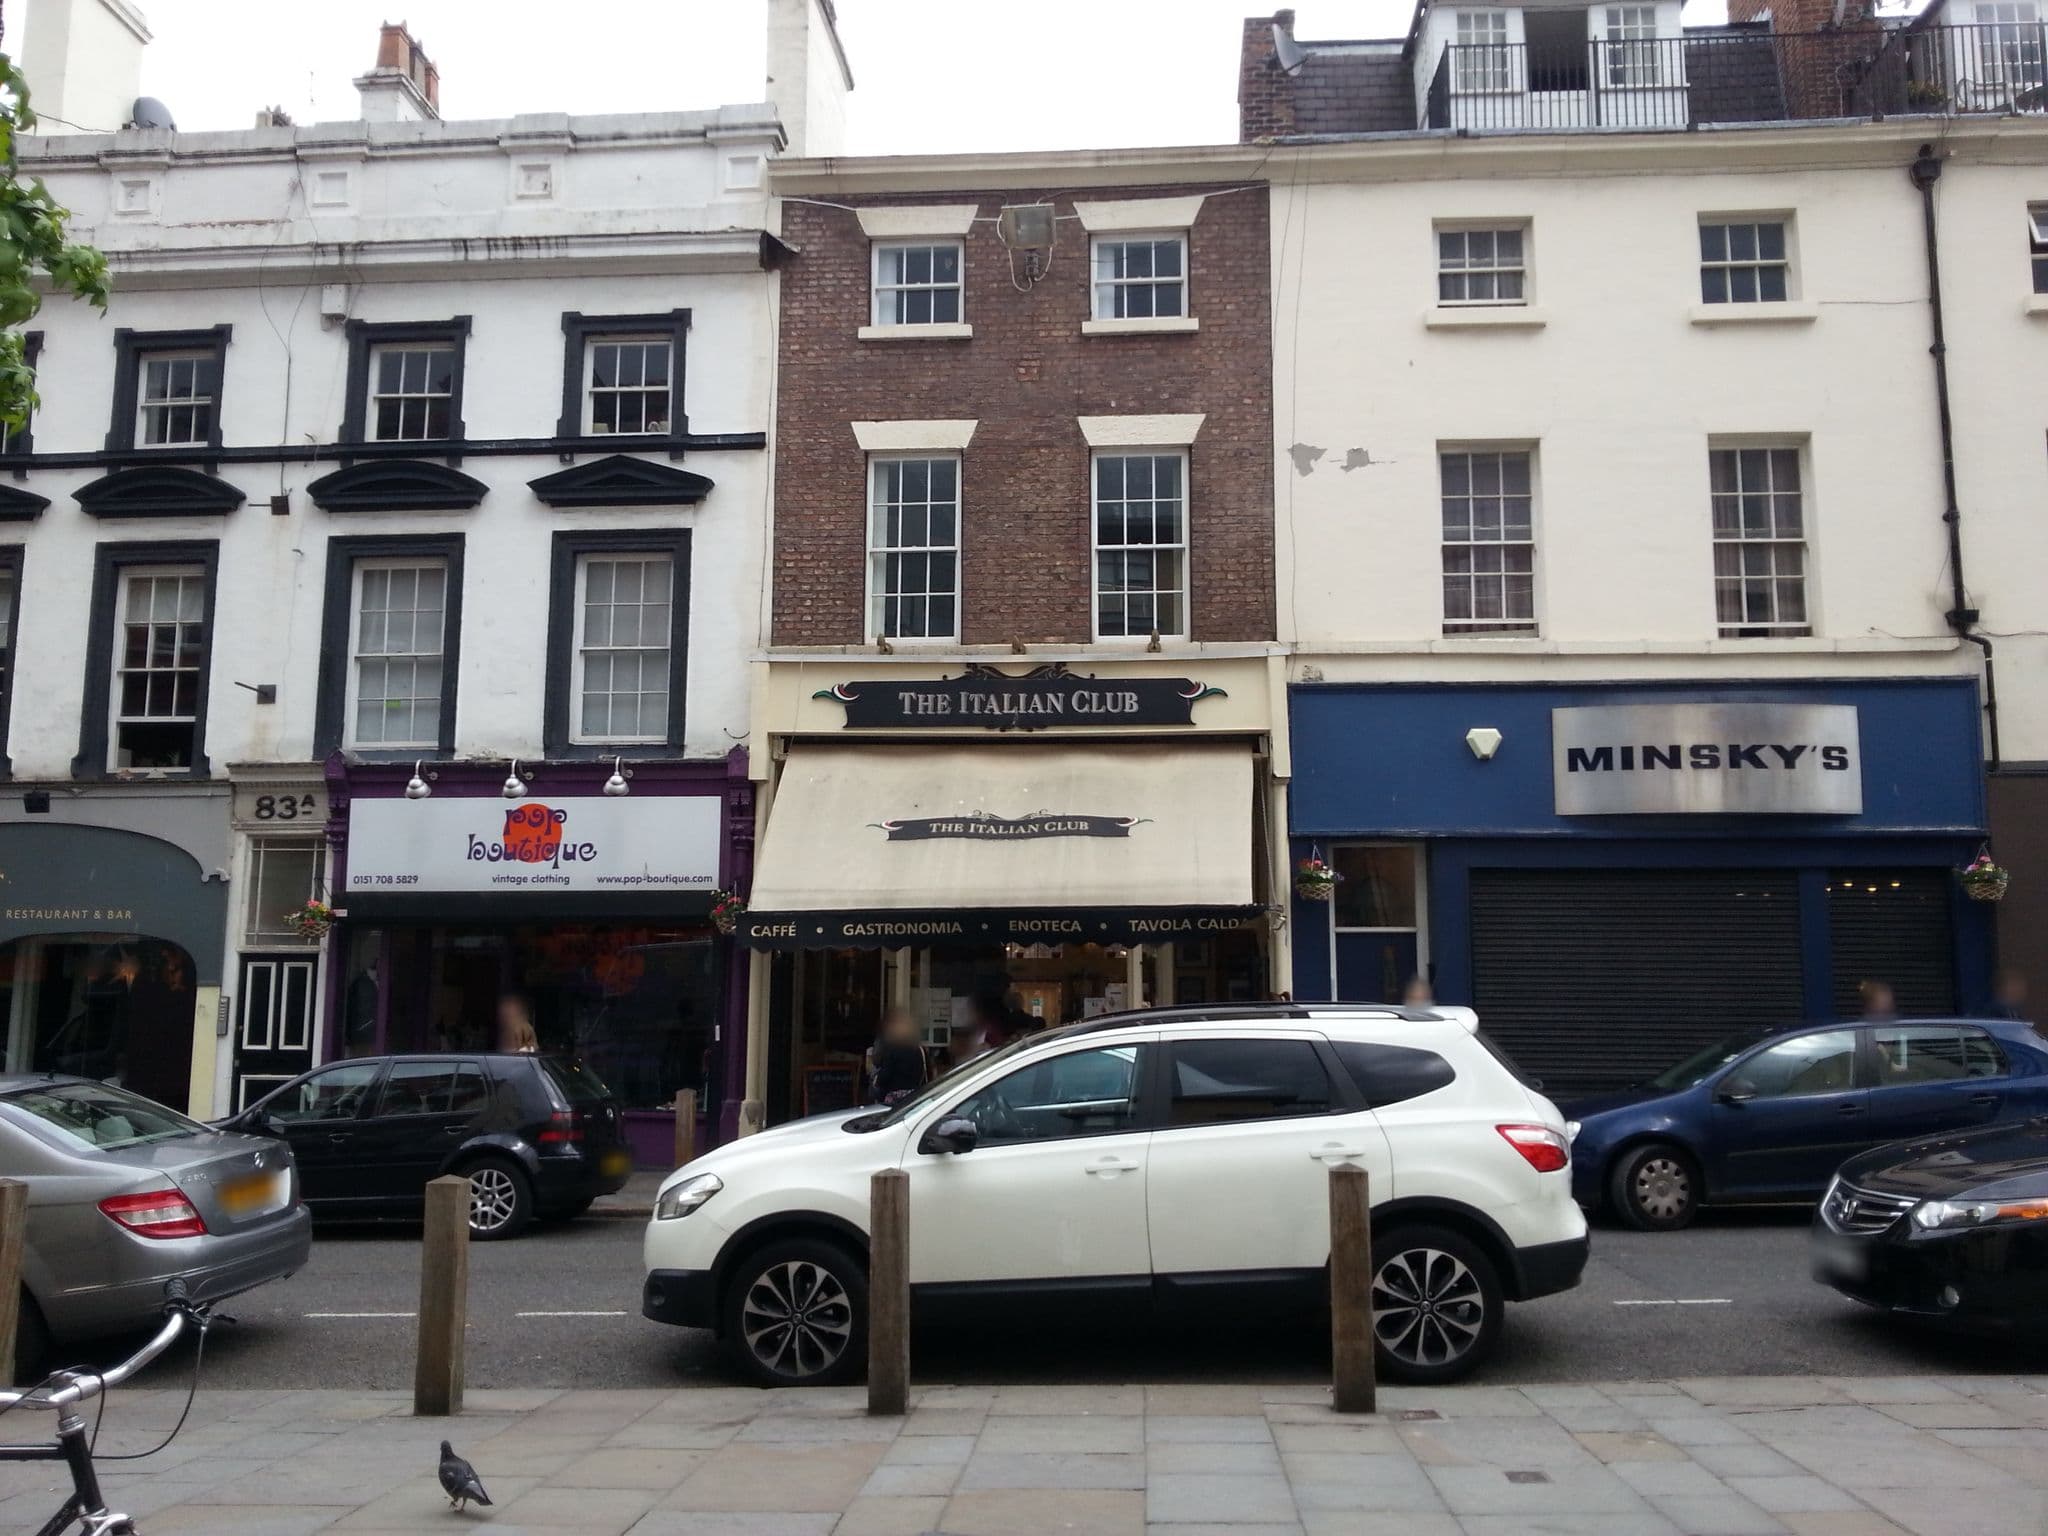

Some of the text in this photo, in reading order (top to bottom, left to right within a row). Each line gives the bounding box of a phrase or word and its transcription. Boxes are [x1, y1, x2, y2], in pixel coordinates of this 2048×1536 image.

[899, 690, 1140, 715] THE ITALIAN CLUB
[1567, 743, 1849, 773] MINSKY'S
[929, 821, 1090, 835] THE ITALIAN CLUB
[467, 833, 597, 870] boutique
[353, 875, 419, 885] 0151 708 5829
[492, 874, 571, 886] vintage clothing
[597, 873, 713, 885] www.pop-boutique.com
[5, 908, 133, 920] RESTAURANT & BAR
[750, 921, 797, 937] CAFFÉ
[842, 921, 963, 936] GASTRONOMIA
[1008, 919, 1082, 932] ENOTECA
[1128, 918, 1192, 932] TAVOLA
